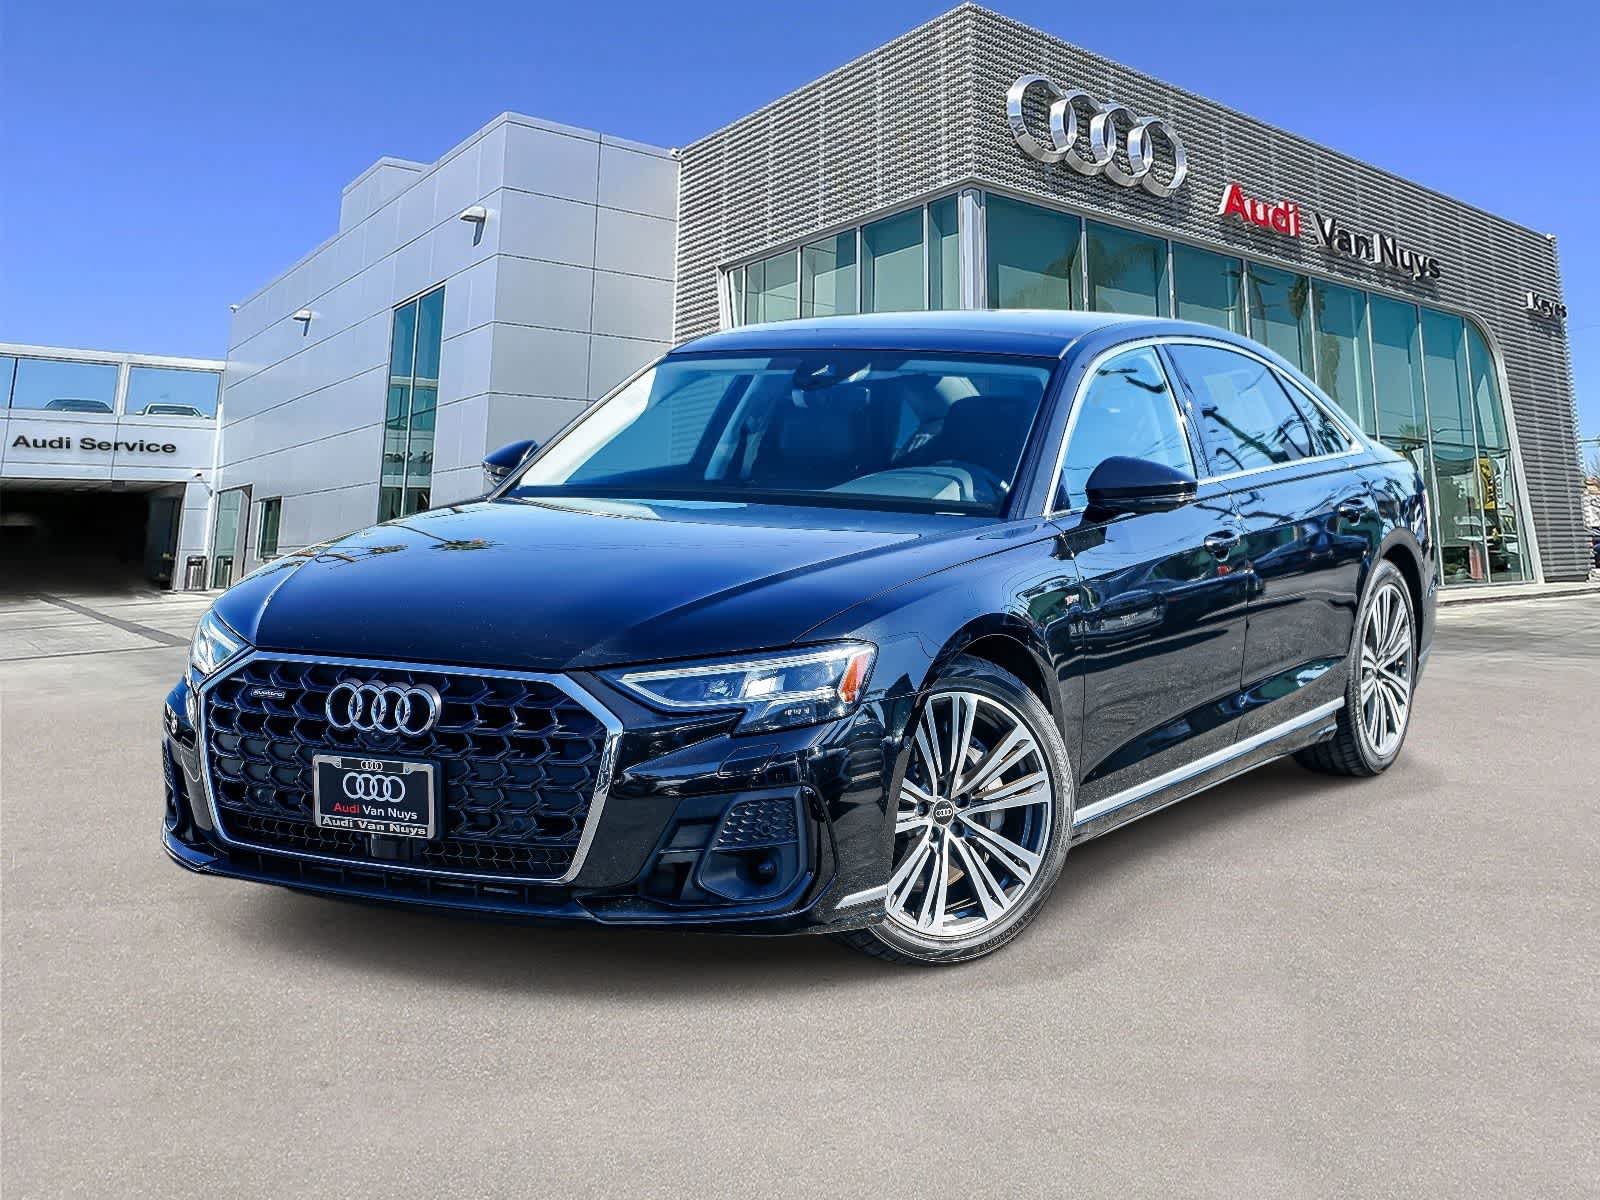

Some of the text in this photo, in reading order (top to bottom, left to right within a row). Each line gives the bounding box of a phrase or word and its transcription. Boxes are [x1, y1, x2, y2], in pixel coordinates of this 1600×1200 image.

[1217, 183, 1441, 280] Audi Van Nuys
[12, 435, 177, 453] Audi Service
[333, 802, 418, 820] Audi Van Nuys
[322, 817, 426, 835] Audi Van Nuys
